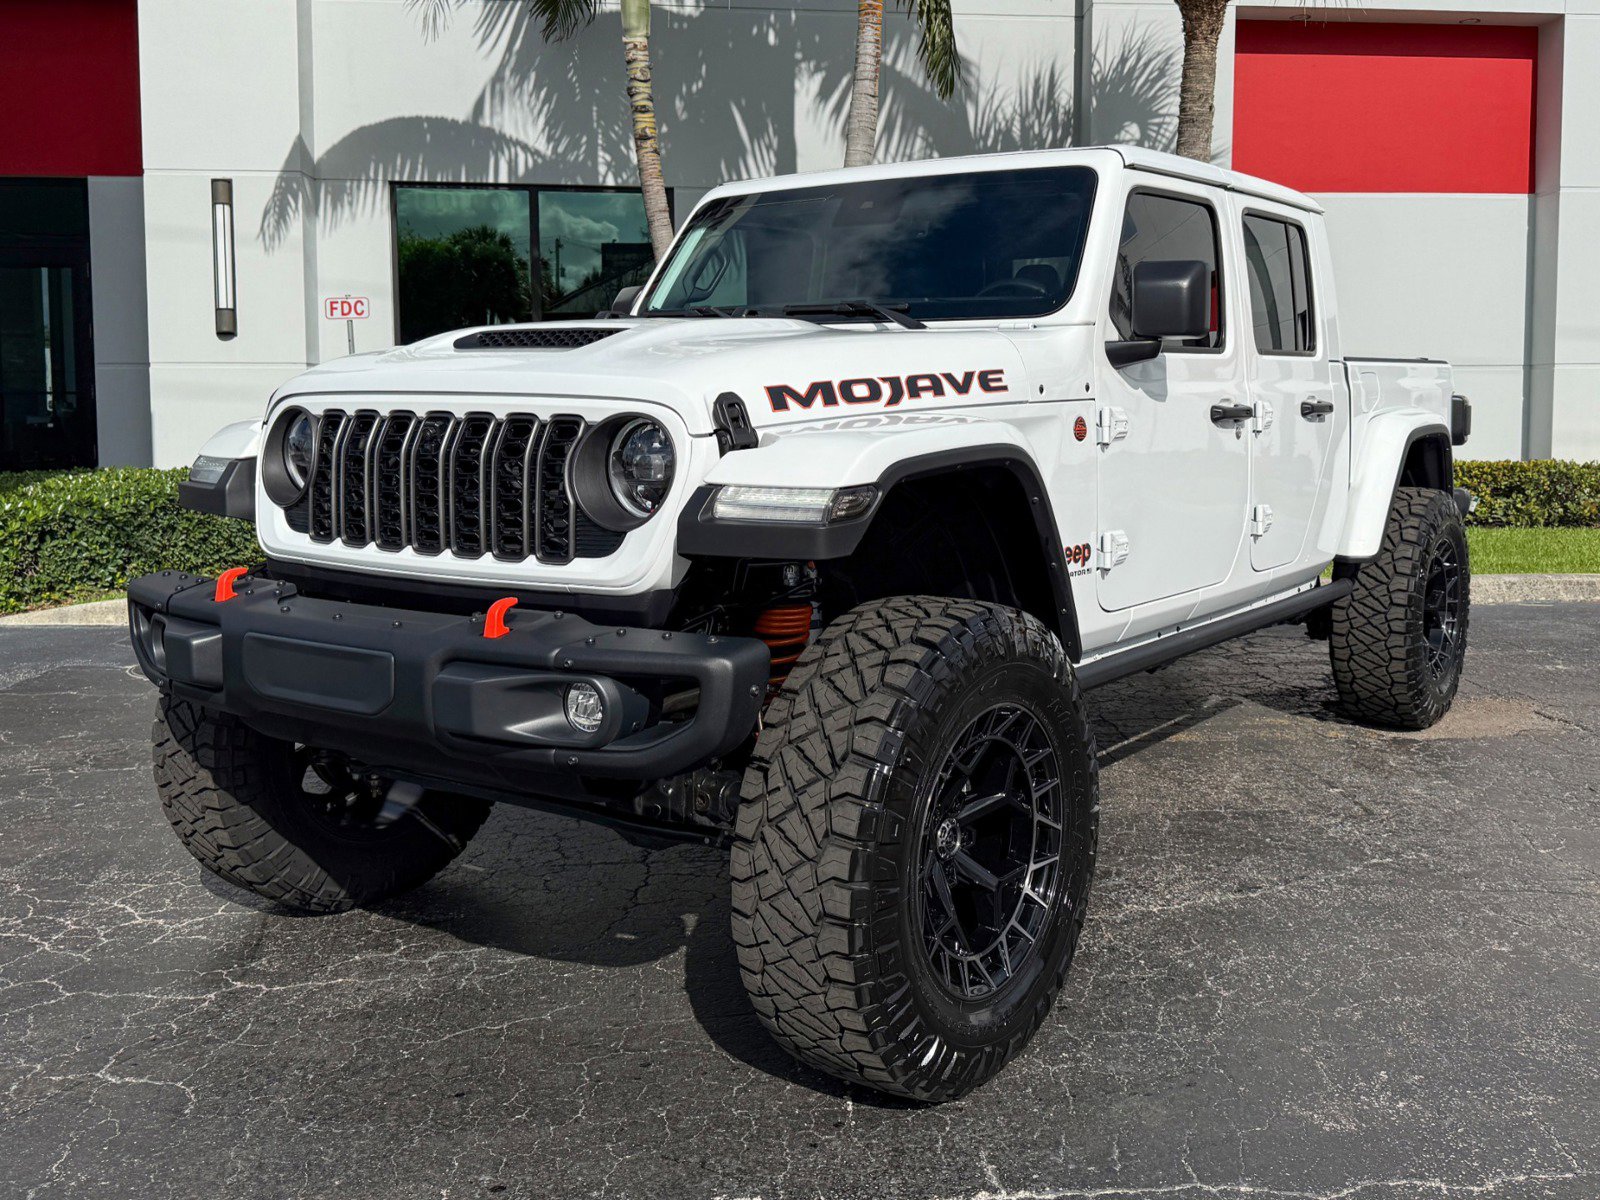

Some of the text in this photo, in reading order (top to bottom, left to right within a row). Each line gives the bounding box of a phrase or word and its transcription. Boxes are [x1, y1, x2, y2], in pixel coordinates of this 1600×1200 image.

[329, 300, 365, 316] FDC
[764, 369, 1009, 412] MOJAVE
[1064, 543, 1091, 567] eep
